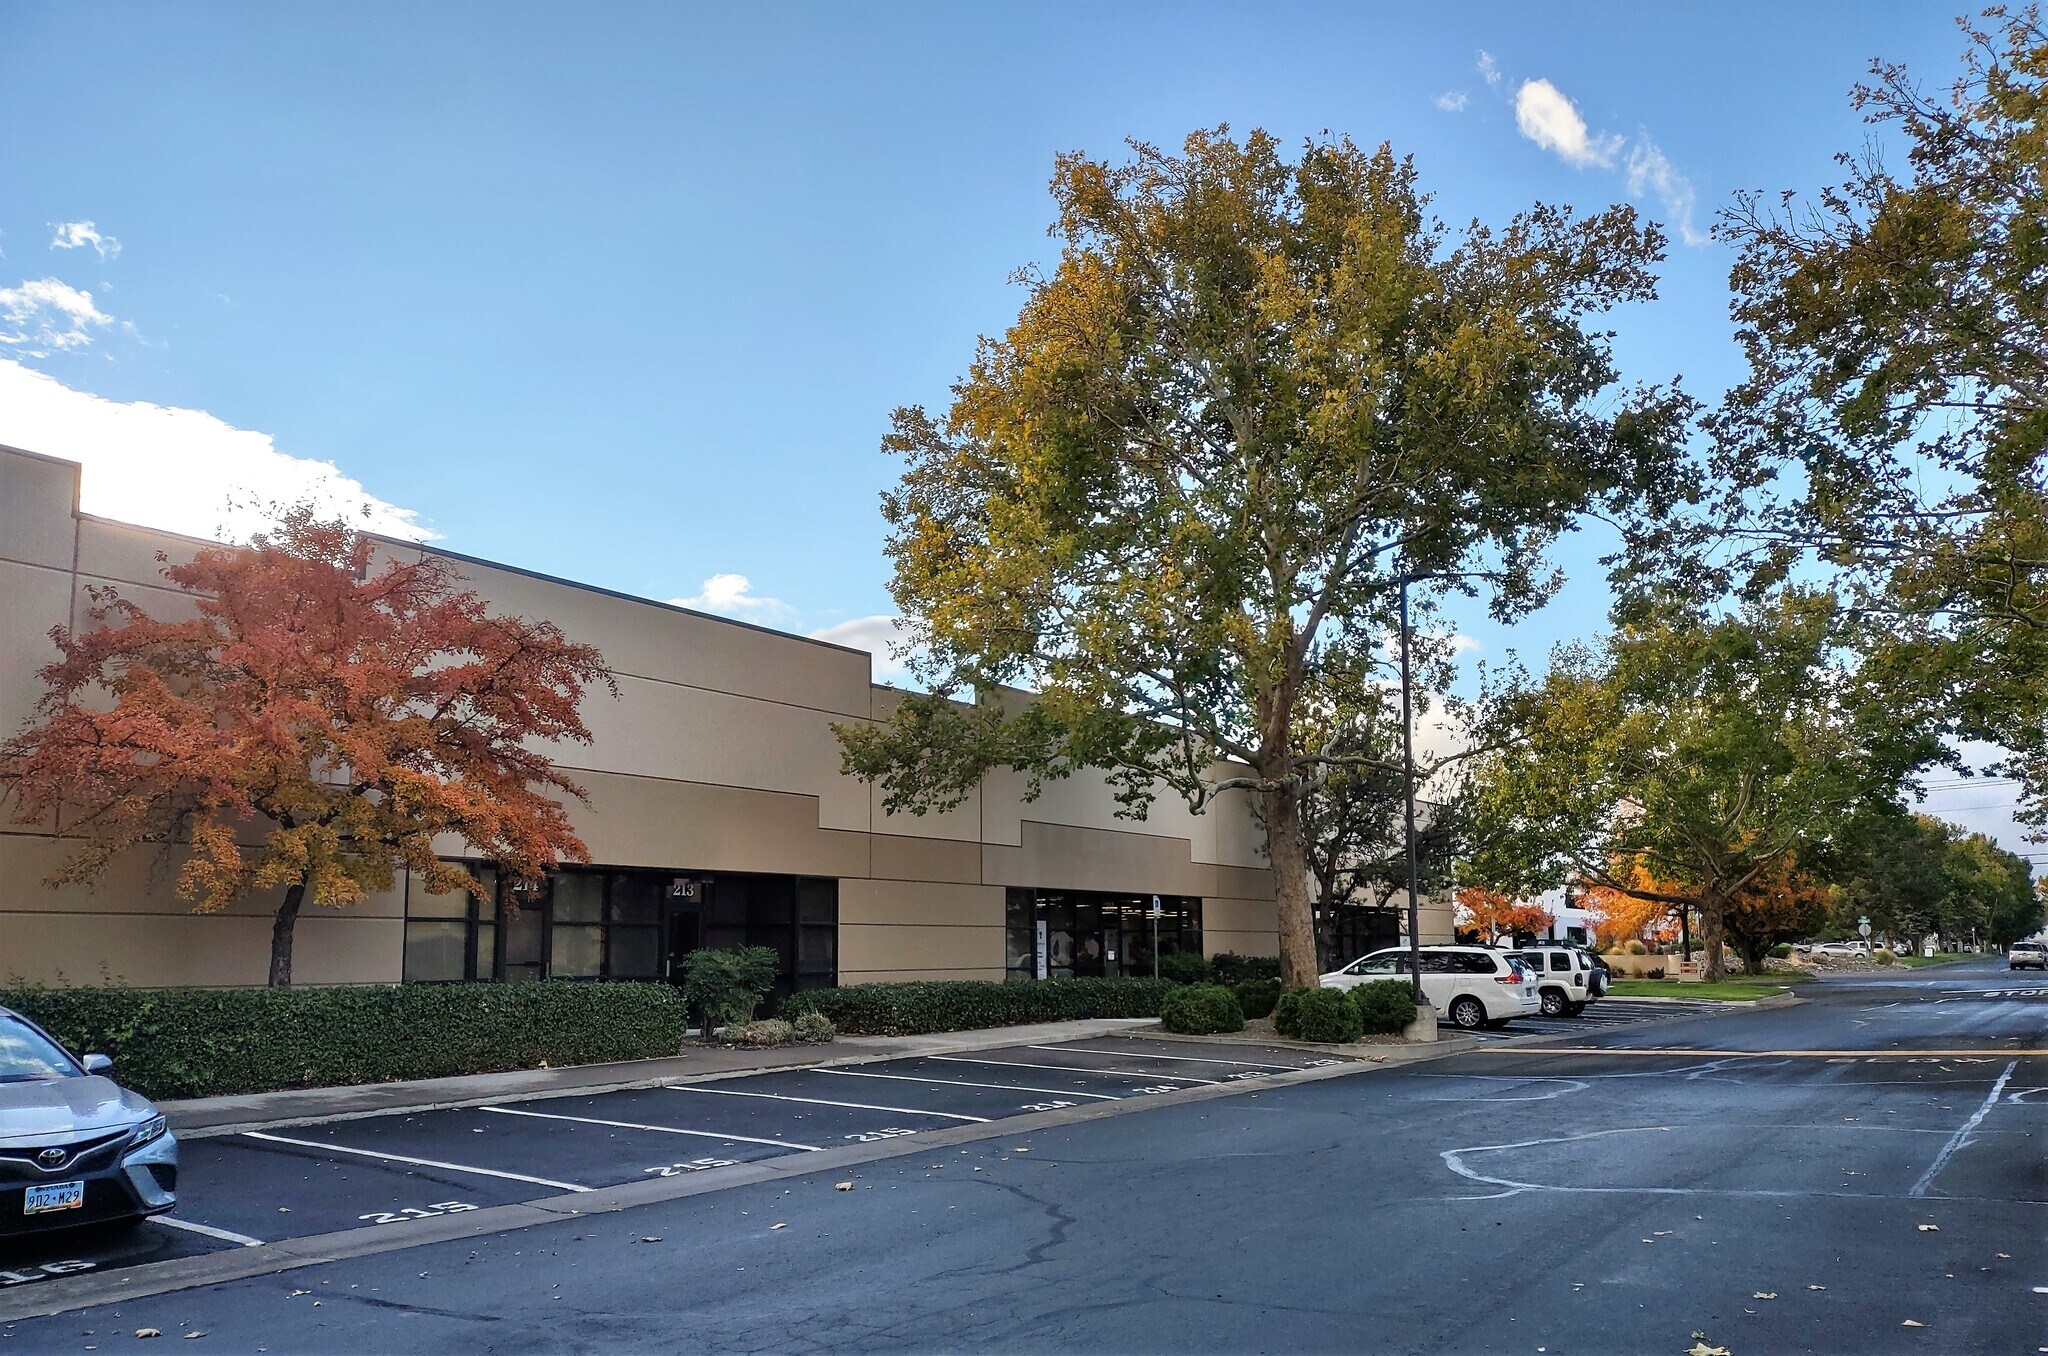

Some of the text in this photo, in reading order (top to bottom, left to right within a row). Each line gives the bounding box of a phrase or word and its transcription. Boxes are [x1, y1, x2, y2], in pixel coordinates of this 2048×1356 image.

[672, 883, 695, 897] 213
[844, 1127, 917, 1142] 215
[644, 1157, 735, 1177] 215
[358, 1201, 479, 1224] 215
[0, 1260, 97, 1285] 16
